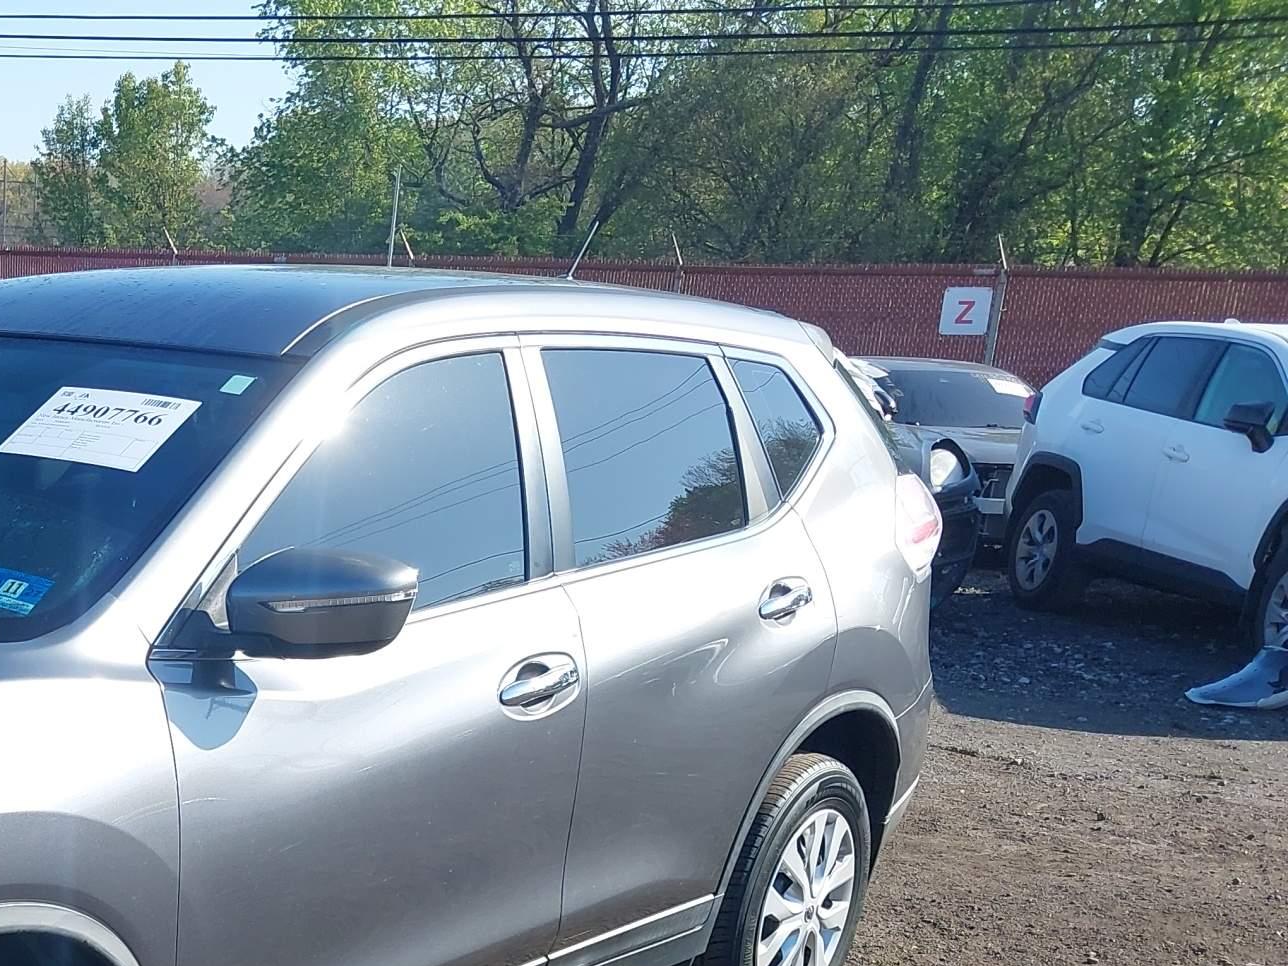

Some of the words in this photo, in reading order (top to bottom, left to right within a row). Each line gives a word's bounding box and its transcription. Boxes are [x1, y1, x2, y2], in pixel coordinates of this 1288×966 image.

[954, 300, 976, 325] Z
[53, 402, 168, 427] 44907766
[2, 581, 24, 595] 11
